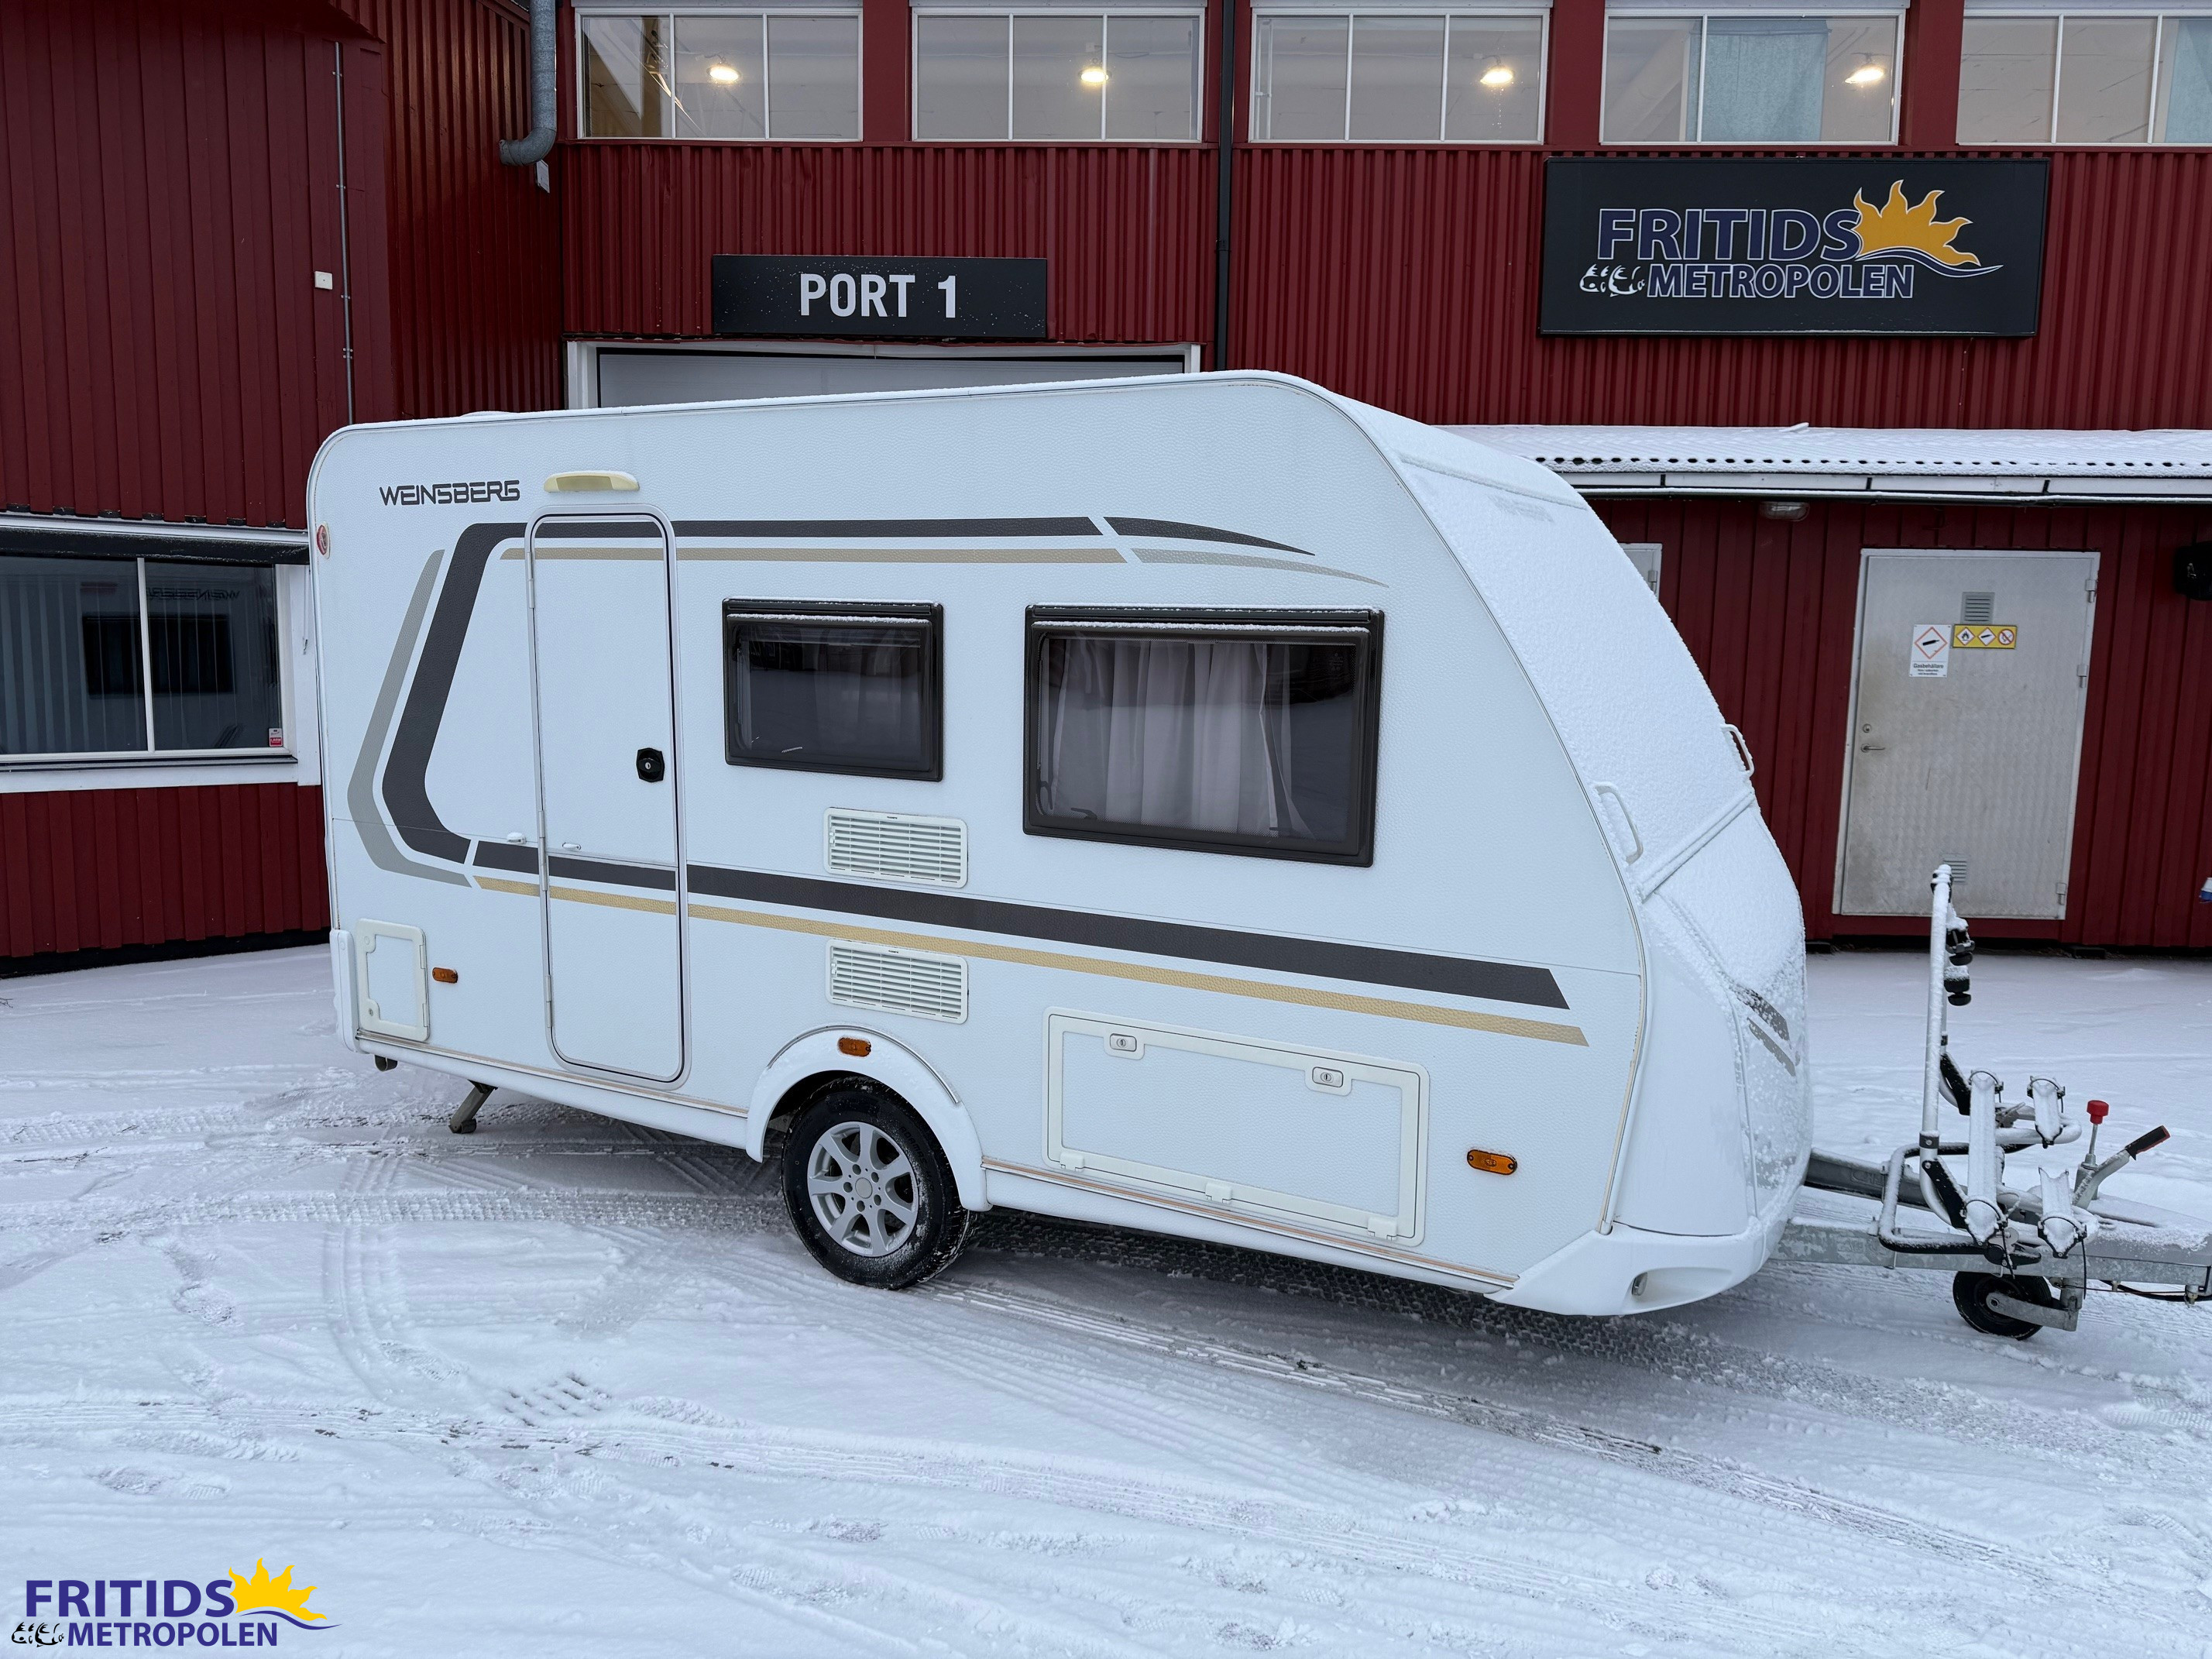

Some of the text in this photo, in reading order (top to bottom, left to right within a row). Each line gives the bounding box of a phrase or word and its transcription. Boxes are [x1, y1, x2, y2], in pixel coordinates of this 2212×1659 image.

[1598, 208, 1863, 262] FRITIDS
[801, 273, 957, 318] PORT 1
[1647, 263, 1915, 299] METROPOLEN
[380, 479, 520, 506] WEINSBERG
